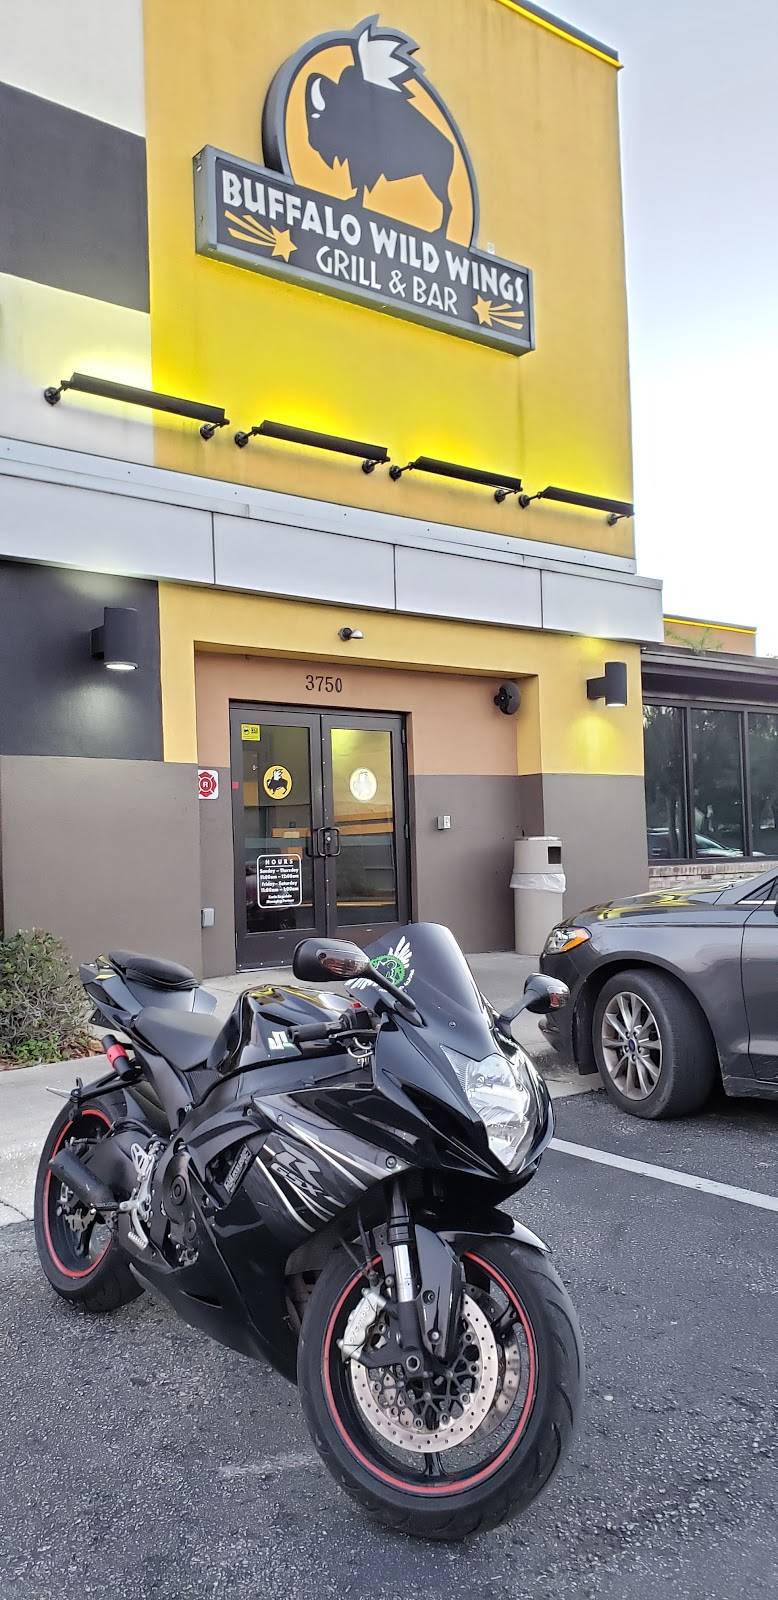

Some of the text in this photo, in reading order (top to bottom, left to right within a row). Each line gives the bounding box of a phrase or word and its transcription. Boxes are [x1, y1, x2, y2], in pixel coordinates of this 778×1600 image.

[222, 170, 524, 305] BUFFALO WILD WINGS
[315, 245, 458, 315] GRILL & BAR
[306, 674, 342, 693] 3750
[270, 1162, 323, 1197] GSX
